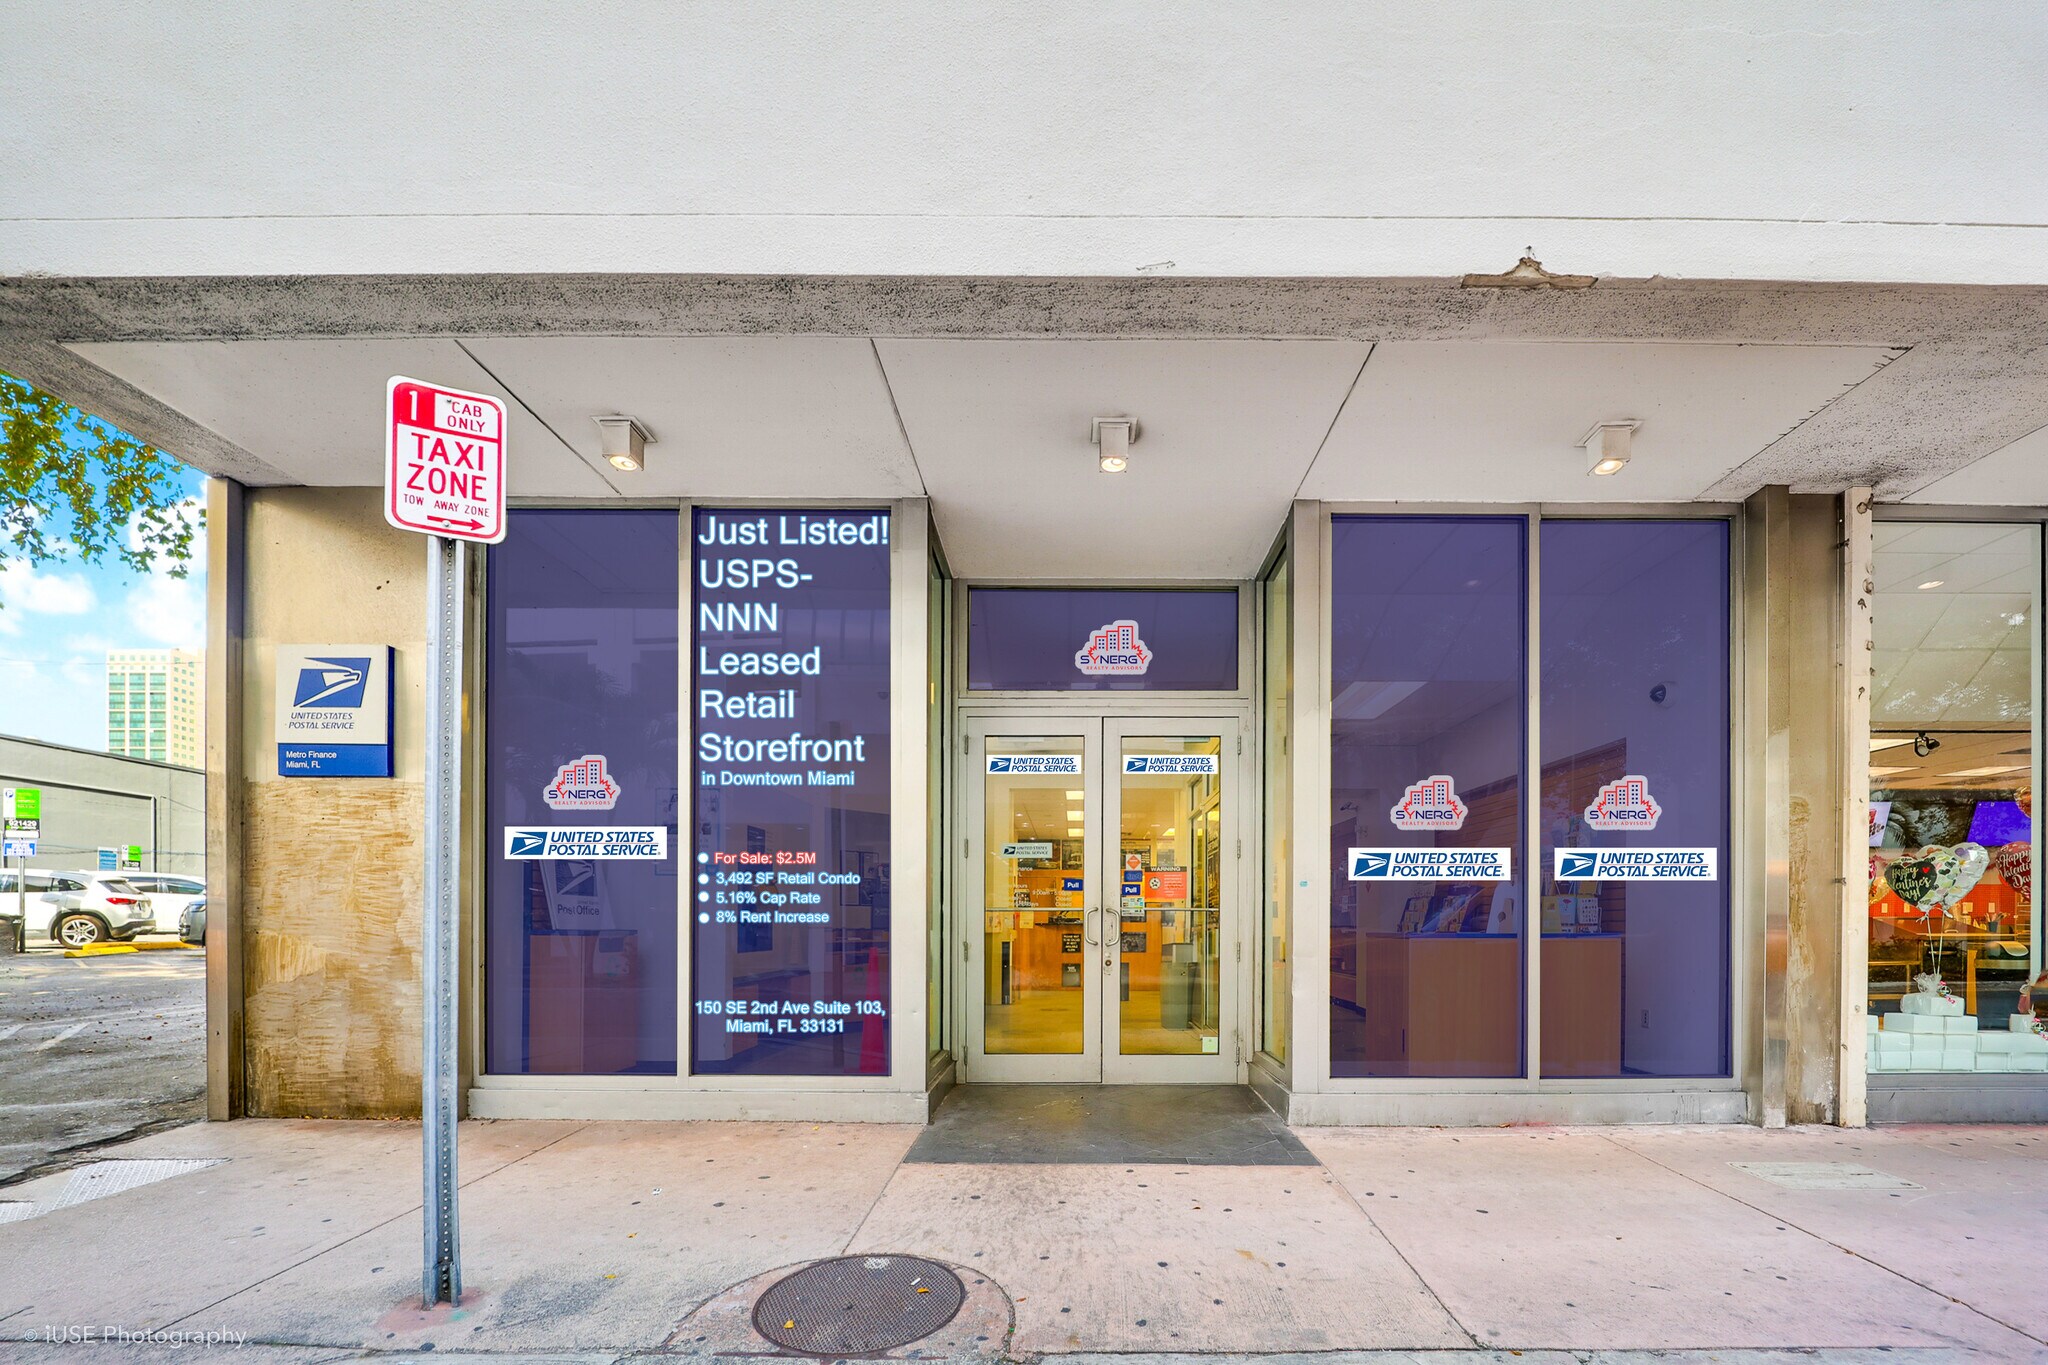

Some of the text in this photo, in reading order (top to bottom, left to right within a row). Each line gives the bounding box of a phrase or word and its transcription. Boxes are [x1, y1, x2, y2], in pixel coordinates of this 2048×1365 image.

[409, 390, 418, 421] 1
[451, 401, 482, 418] CAB
[447, 415, 486, 433] ONLY
[411, 432, 485, 471] TAXI
[406, 463, 487, 502] ZONE
[403, 493, 490, 518] TOW AWAY ZONE
[698, 515, 890, 546] Just Listed!
[699, 558, 813, 589] USPS-
[700, 602, 778, 632] NNN
[700, 645, 822, 676] Leased
[1080, 654, 1148, 665] SYNERGY
[700, 688, 796, 719] Retail
[291, 712, 353, 720] UNITED STATES
[288, 721, 319, 729] POSTAL
[698, 732, 866, 762] Storefront
[285, 750, 337, 758] Metro Finance
[285, 760, 321, 769] Miami, FL
[1013, 757, 1075, 765] UNITED STATES
[1150, 757, 1211, 765] UNITED STATES
[701, 771, 855, 786] in Downtown Miami
[548, 789, 616, 799] SYNERGY
[1395, 810, 1463, 819] SYNERGY
[1589, 810, 1657, 819] SYNERGY
[550, 831, 655, 842] UNITED STATES
[548, 844, 600, 855] POSTAL
[713, 851, 816, 865] For Sale: $2.5M
[1394, 852, 1499, 864] UNITED STATES
[1600, 852, 1705, 864] UNITED STATES
[1391, 865, 1443, 877] POSTAL
[1597, 865, 1649, 877] POSTAL
[715, 872, 861, 886] 3,492 SF Retail Condo
[715, 891, 821, 906] 5.16% Cap Rate
[557, 904, 600, 916] Post Office
[715, 910, 830, 923] 8% Rent Increase
[695, 1000, 886, 1016] 150 SE 2nd Ave Suite 103,
[725, 1018, 844, 1035] Miami, FL 33131
